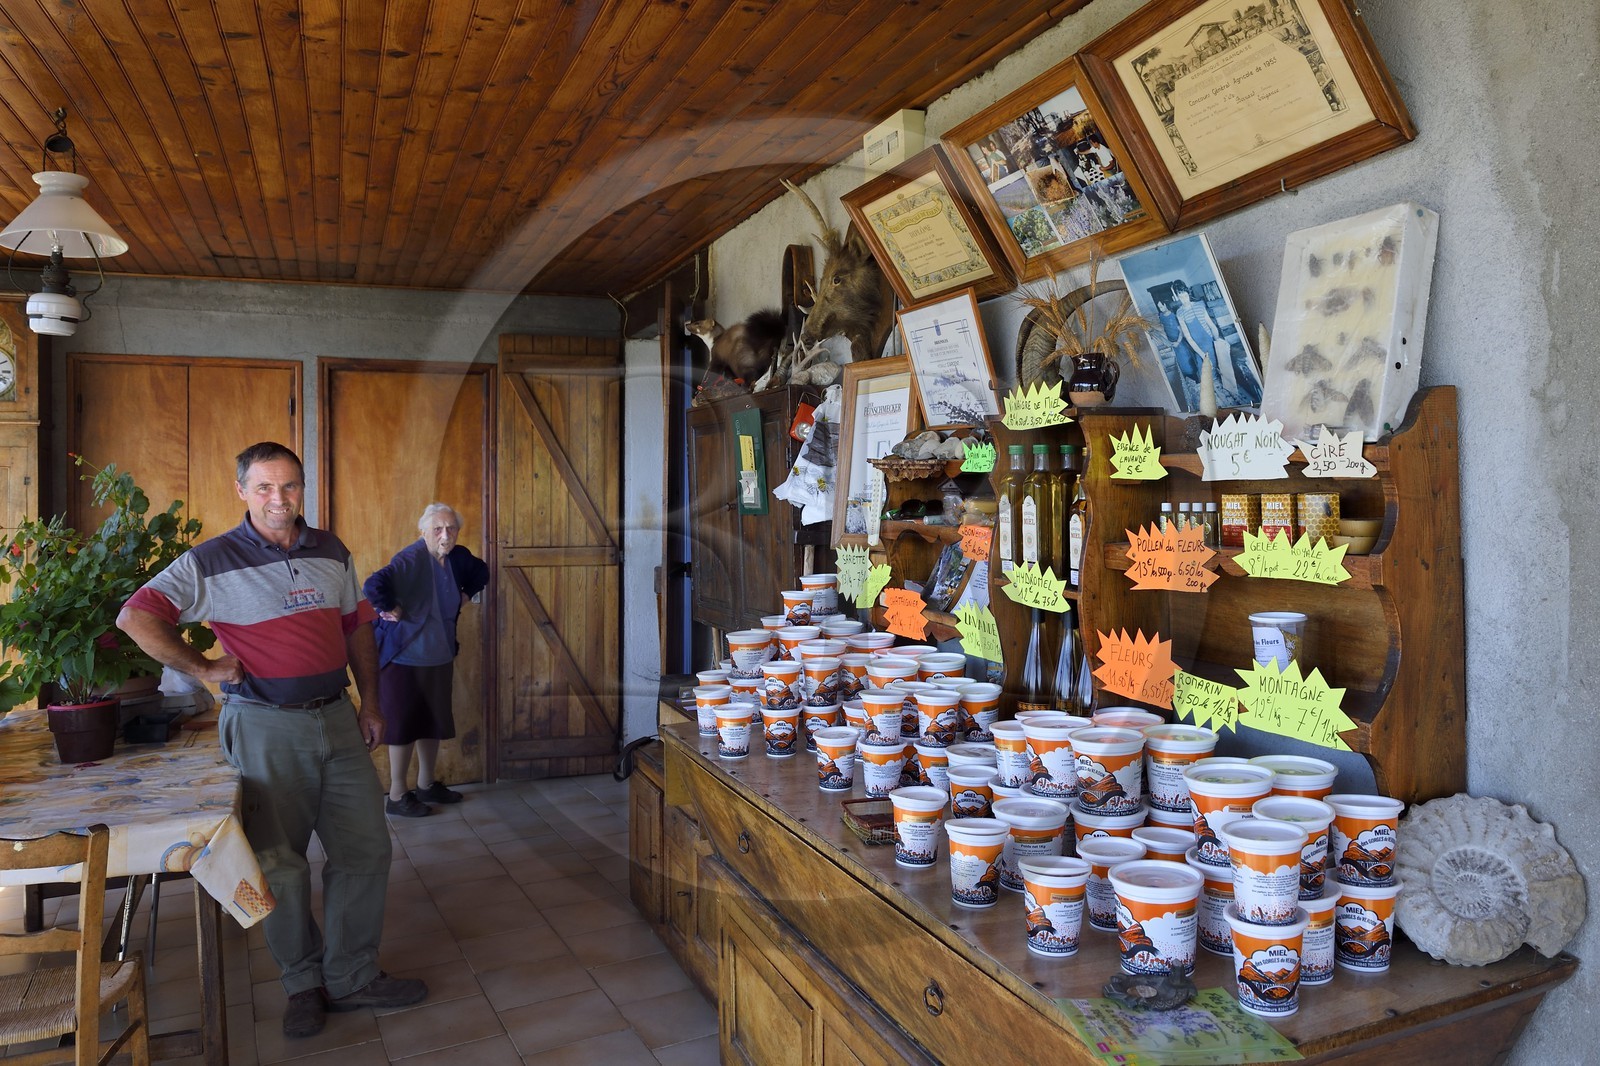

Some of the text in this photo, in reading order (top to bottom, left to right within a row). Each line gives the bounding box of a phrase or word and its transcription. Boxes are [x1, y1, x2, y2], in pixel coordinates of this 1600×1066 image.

[1188, 93, 1211, 107] Concours
[1212, 82, 1231, 96] Général
[1233, 70, 1254, 84] Agricole
[1255, 65, 1262, 73] de
[1044, 396, 1061, 409] MIEL
[1206, 432, 1248, 451] NOUGAT
[1120, 455, 1147, 464] LAVANDE
[1225, 502, 1242, 510] MIEL
[1266, 502, 1284, 510] MIEL
[1137, 537, 1206, 553] POLLEN des FLEURS
[1291, 547, 1322, 559] ROYALE
[1015, 570, 1053, 592] HYDROMEL
[1110, 643, 1154, 670] FLEURS
[1178, 672, 1224, 696] ROMARIN
[1259, 675, 1325, 702] MONTAGNE
[1079, 758, 1093, 767] MIEL
[1374, 828, 1390, 836] MIEL
[1345, 906, 1364, 915] MIEL
[1268, 949, 1288, 957] MIEL
[1263, 957, 1281, 966] GORGES
